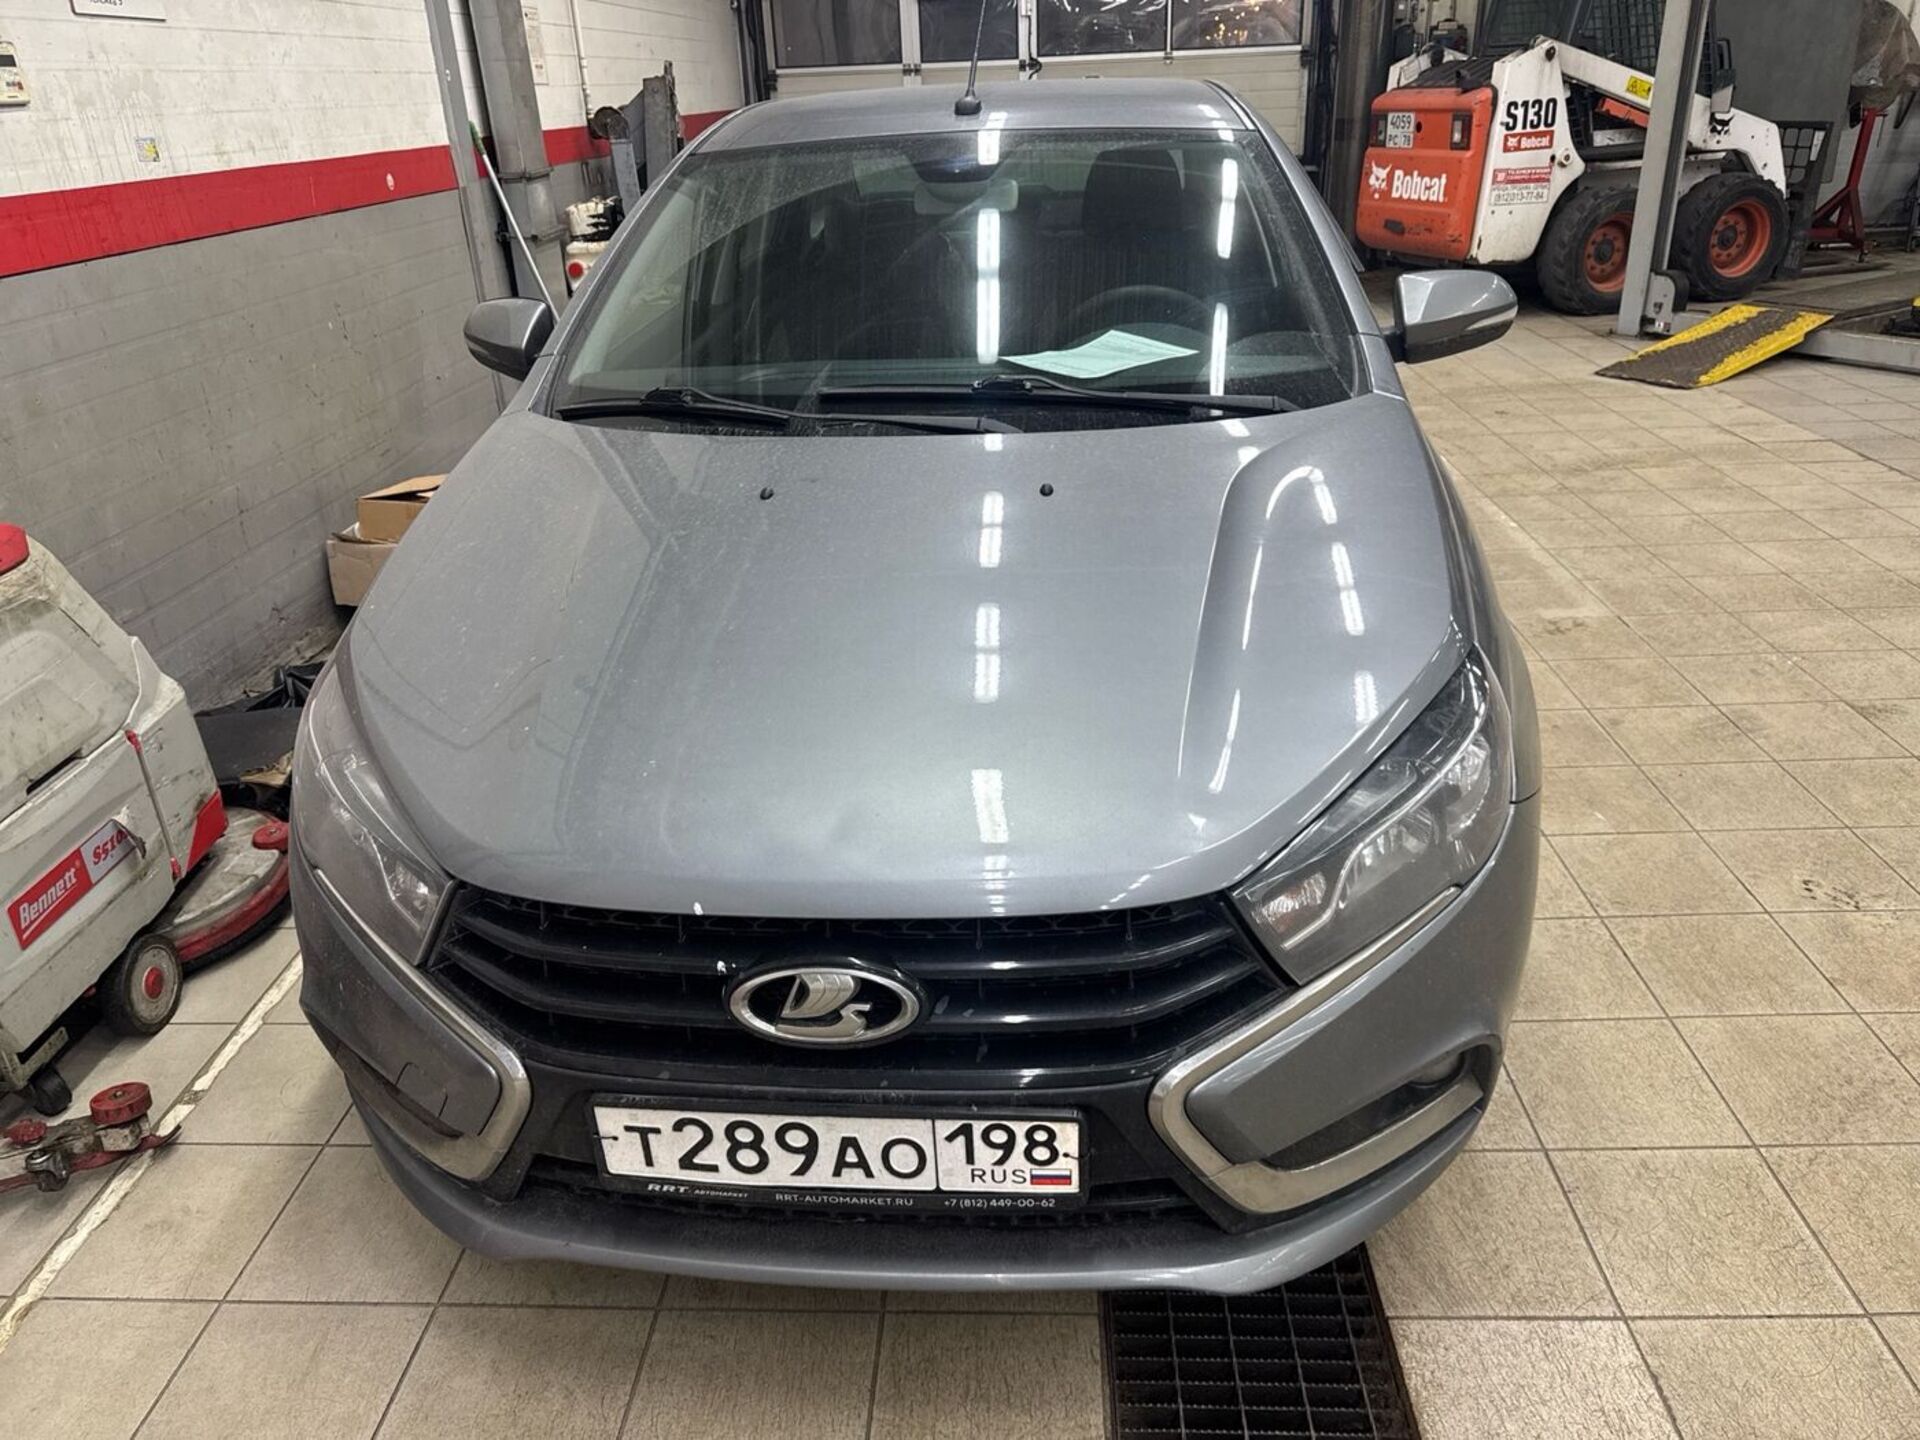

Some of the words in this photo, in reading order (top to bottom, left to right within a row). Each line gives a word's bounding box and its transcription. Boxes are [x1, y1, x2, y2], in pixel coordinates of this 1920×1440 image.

[1390, 114, 1412, 130] 4059
[1505, 98, 1557, 131] S130
[1520, 135, 1550, 149] Bobcat
[1391, 169, 1447, 203] Bobcat
[19, 867, 78, 930] Bennett
[944, 1122, 1060, 1167] 198
[970, 1168, 1027, 1184] RUS
[647, 1182, 690, 1194] RRT
[775, 1192, 914, 1207] RRT-AUTOMARKET.RU
[944, 1200, 957, 1208] +7
[959, 1198, 987, 1209] (812)
[989, 1198, 1056, 1208] 449-00-62
